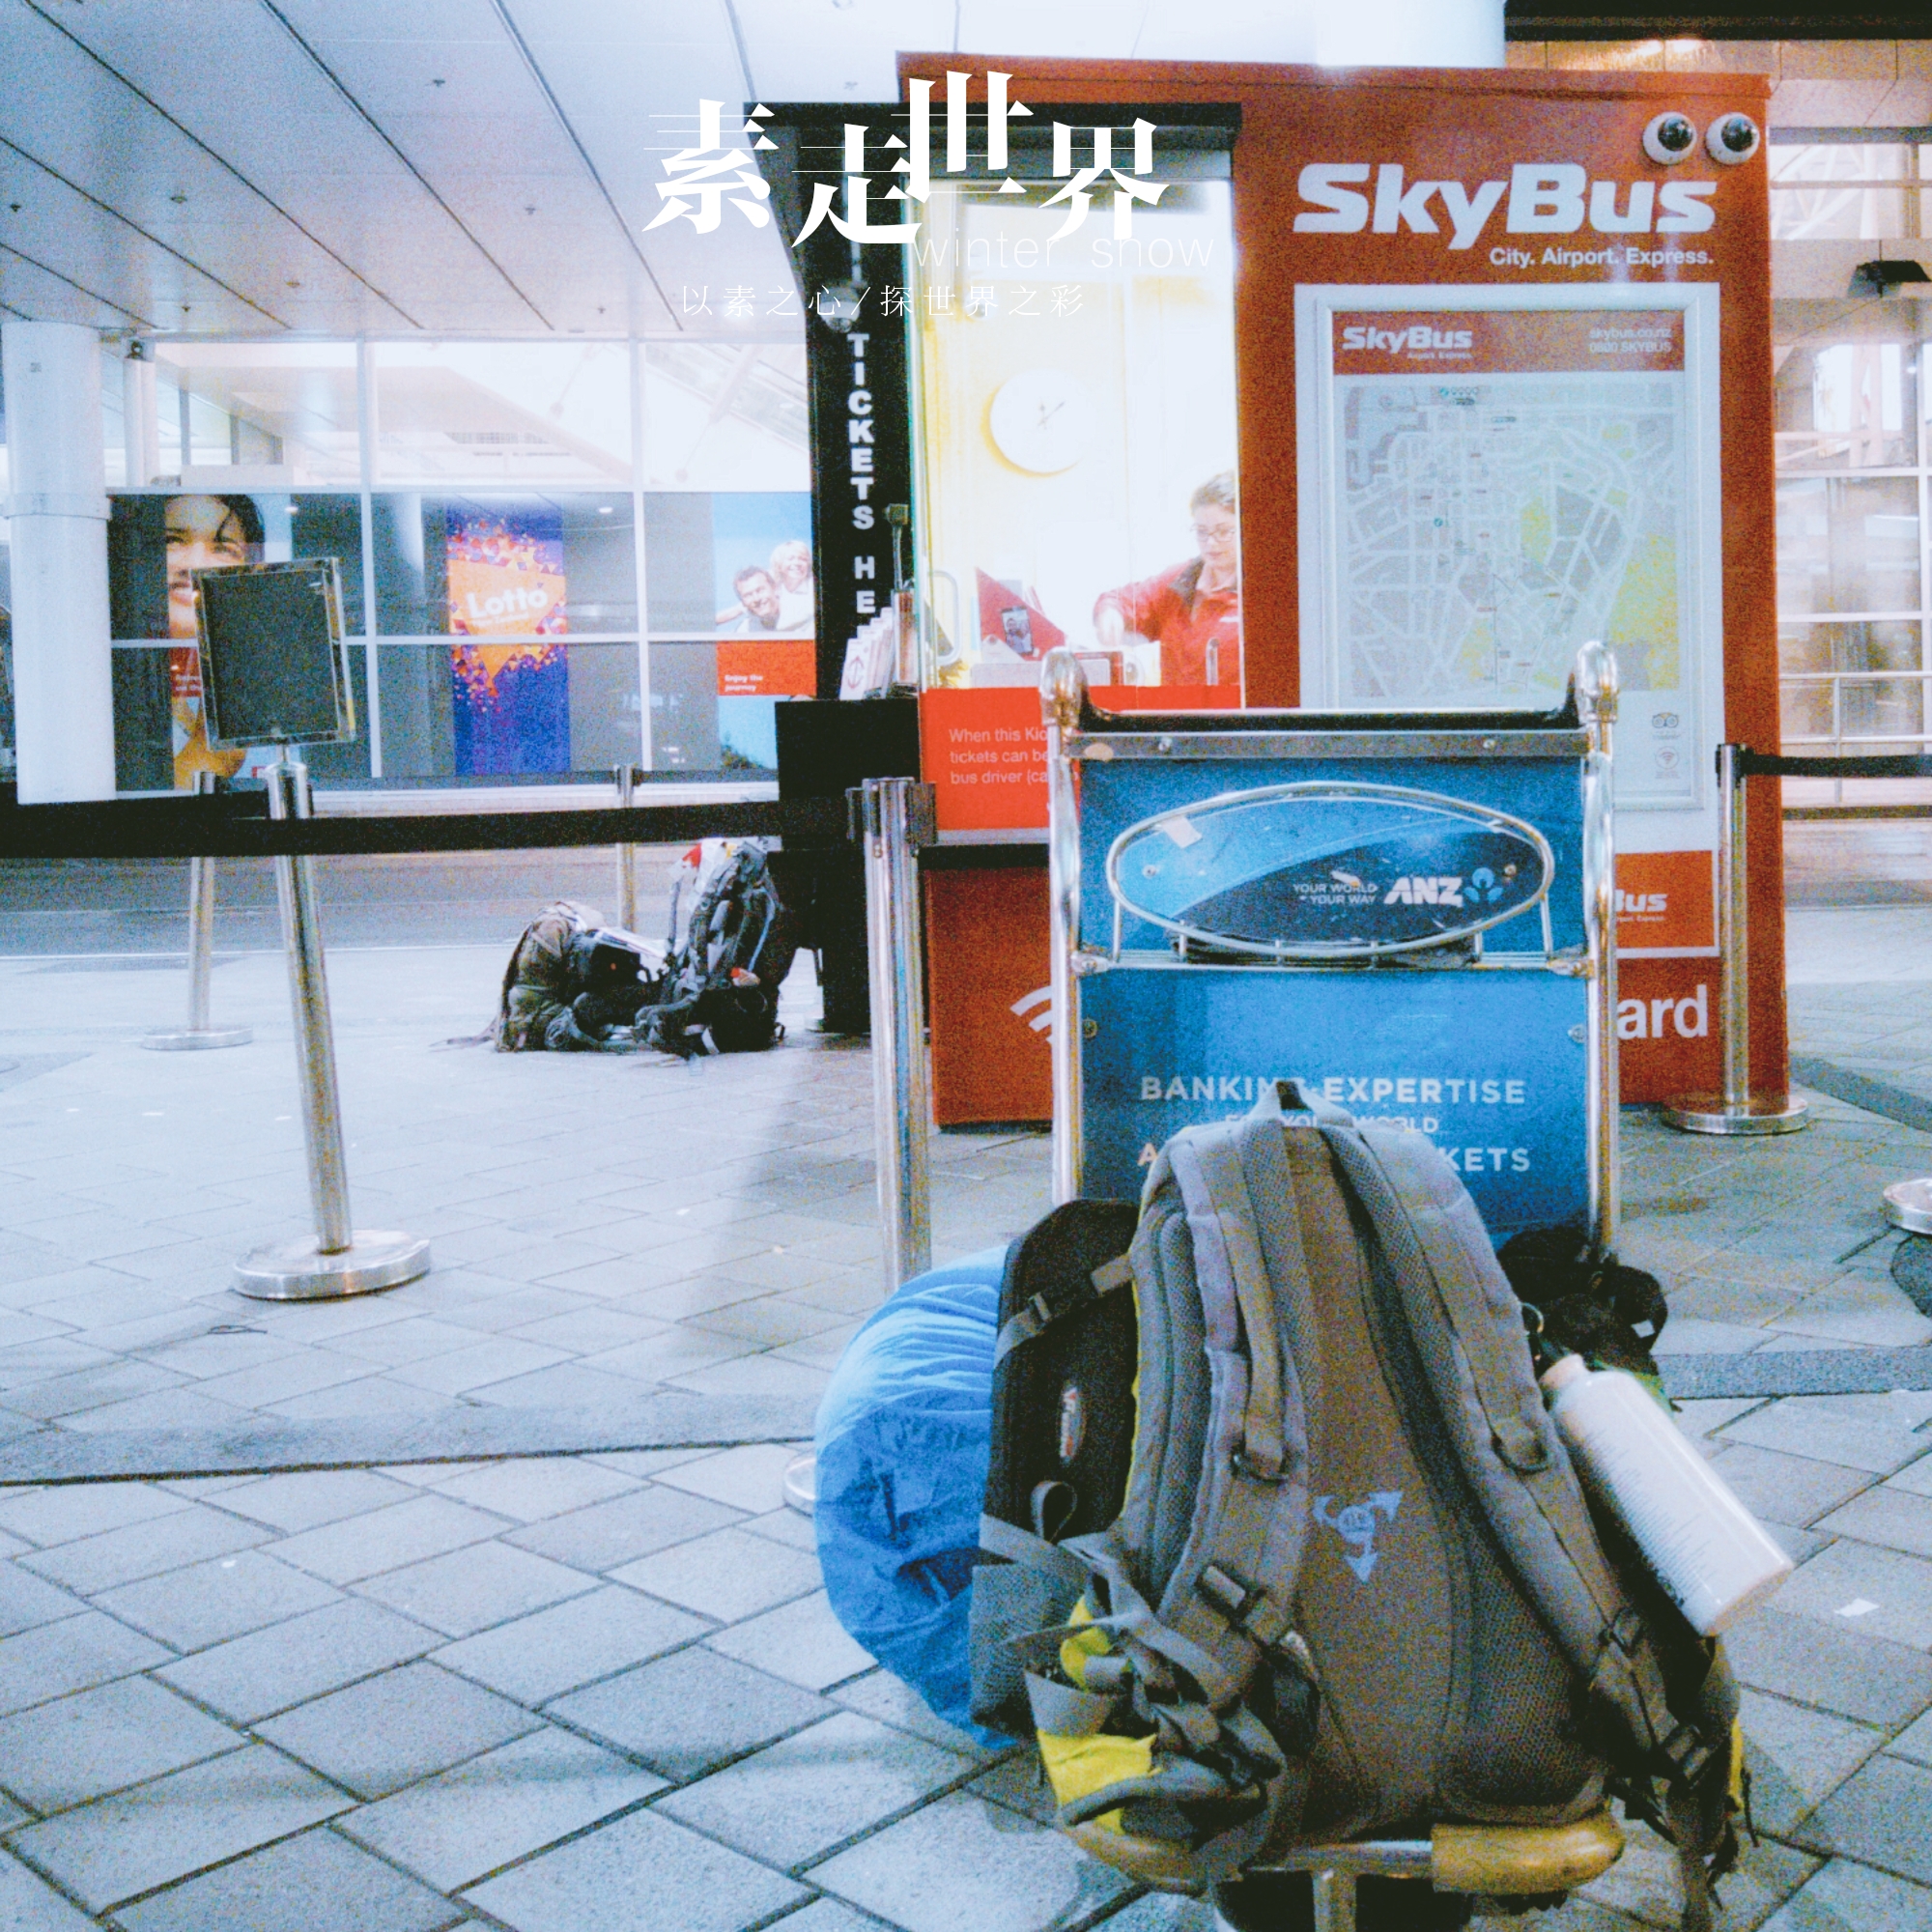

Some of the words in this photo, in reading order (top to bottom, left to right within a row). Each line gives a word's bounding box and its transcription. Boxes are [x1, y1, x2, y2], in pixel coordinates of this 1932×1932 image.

[1293, 162, 1718, 250] SkyBus
[1489, 246, 1536, 269] City.
[1541, 246, 1619, 269] Airport.
[1625, 246, 1715, 269] Express.
[1342, 326, 1473, 355] SkyBus
[846, 332, 876, 531] TICKETS
[854, 555, 876, 614] HE
[467, 586, 549, 618] Lotto
[949, 727, 991, 743] When
[994, 727, 1021, 742] this
[950, 751, 998, 764] tickets
[1001, 752, 1029, 763] can
[951, 771, 979, 784] bus
[981, 770, 1022, 783] driver
[1026, 770, 1049, 785] (ca
[1293, 883, 1327, 894] YOUR
[1331, 883, 1377, 894] WORLD
[1310, 895, 1346, 905] YOUR
[1348, 895, 1377, 905] WAY
[1383, 876, 1463, 906] ANZ
[1616, 983, 1709, 1038] ard
[1322, 1076, 1526, 1105] EXPERTISE
[1438, 1147, 1531, 1173] KETS
